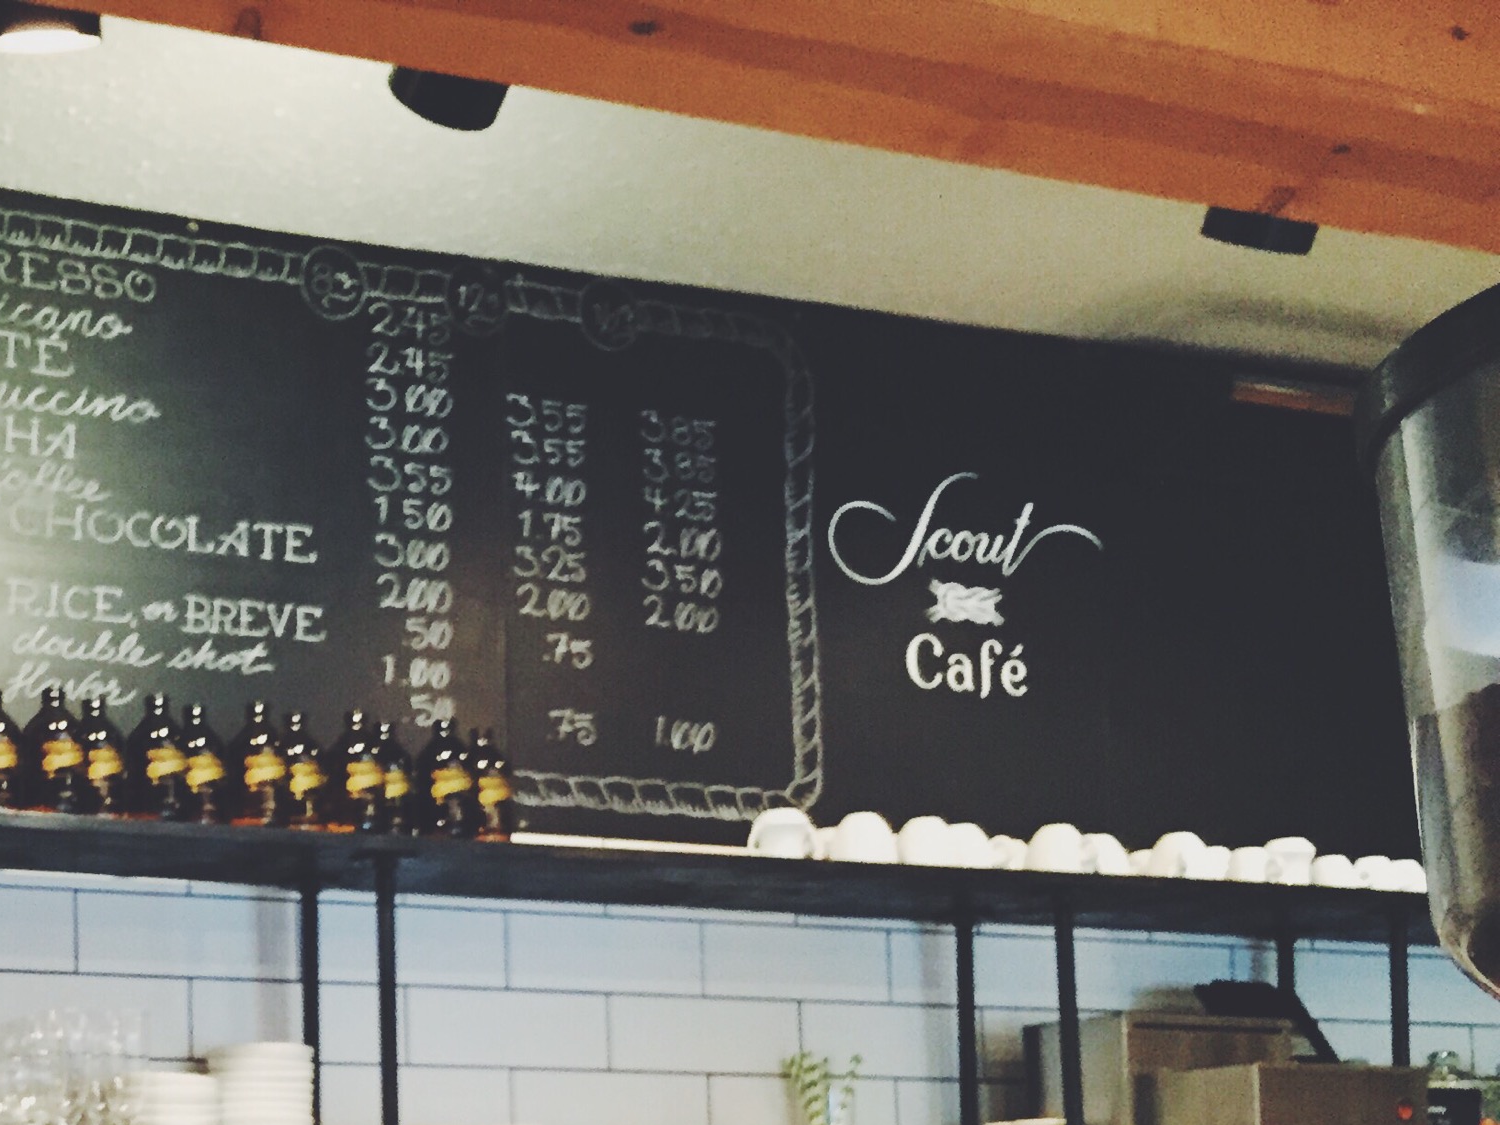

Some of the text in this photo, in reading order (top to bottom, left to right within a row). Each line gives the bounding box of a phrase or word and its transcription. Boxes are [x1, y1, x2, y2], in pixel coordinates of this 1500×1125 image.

[9, 504, 318, 564] CHOCOLATE
[827, 471, 1103, 586] Scout
[182, 592, 328, 643] BREVE
[12, 625, 164, 668] double
[167, 640, 276, 675] shot
[905, 632, 1029, 699] Café
